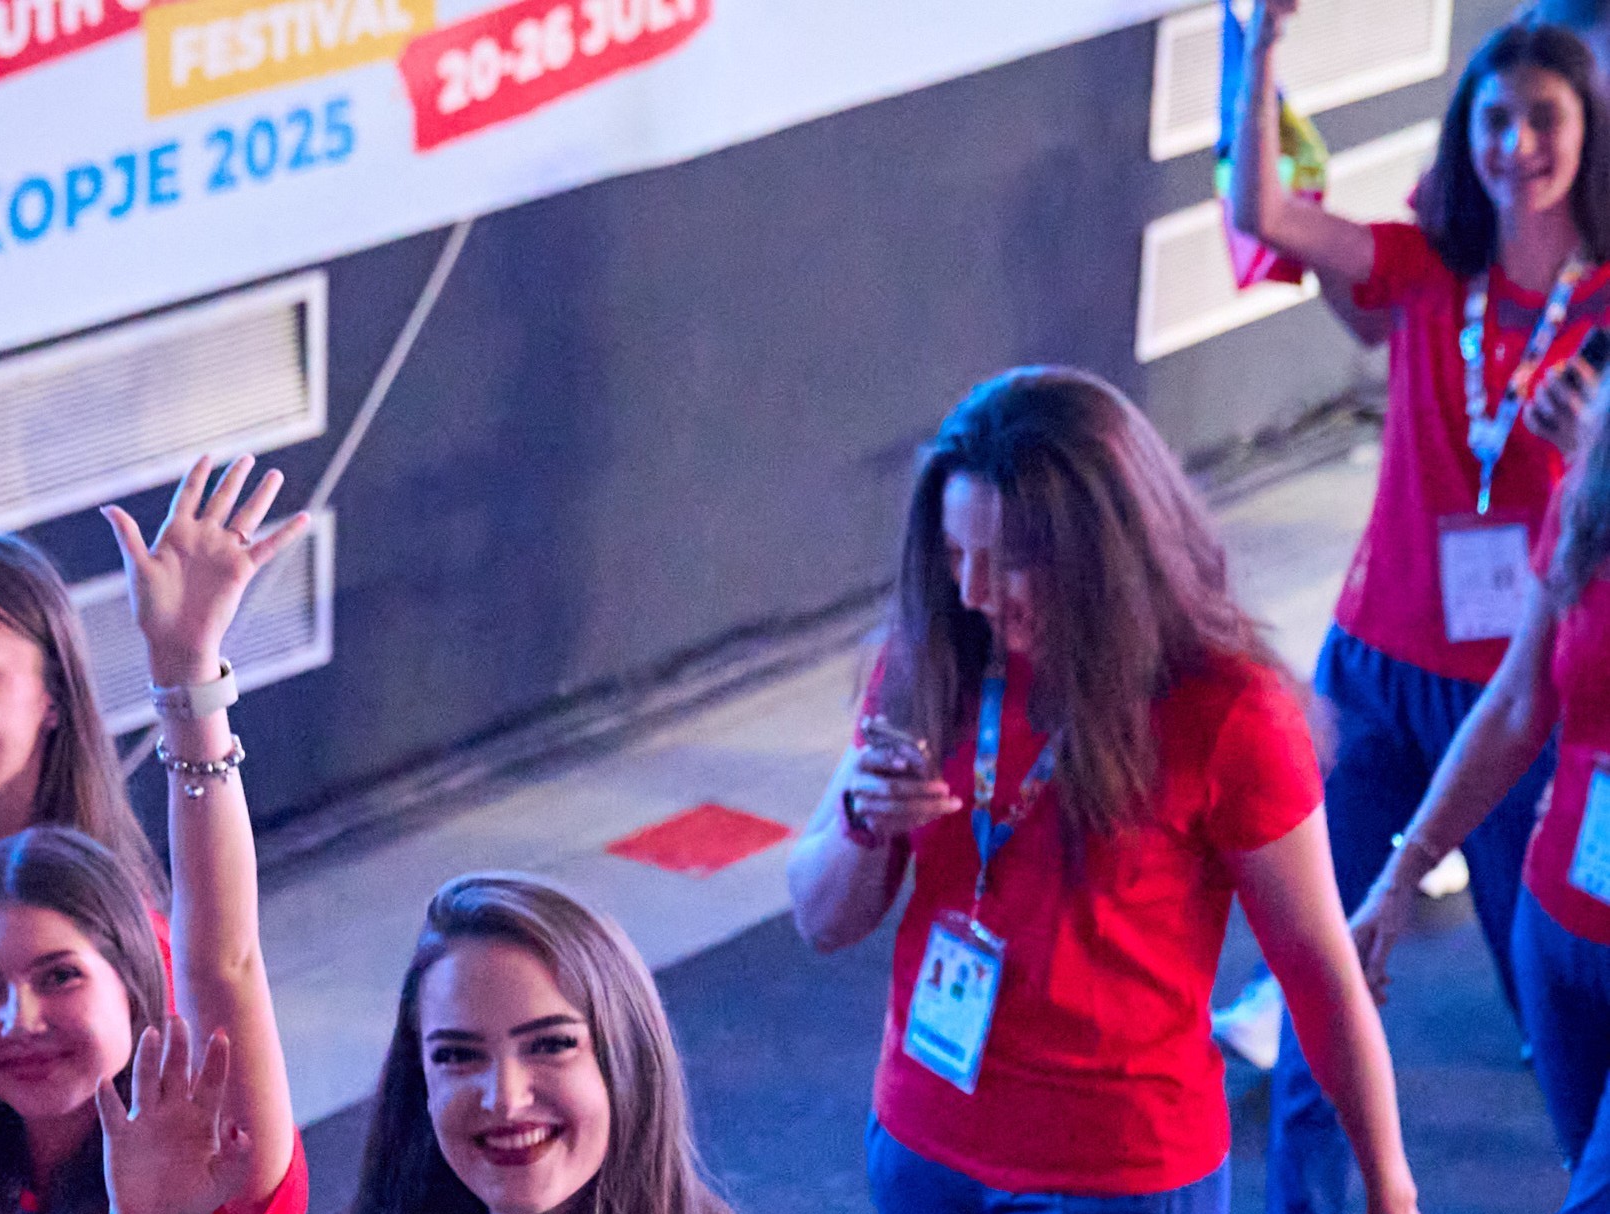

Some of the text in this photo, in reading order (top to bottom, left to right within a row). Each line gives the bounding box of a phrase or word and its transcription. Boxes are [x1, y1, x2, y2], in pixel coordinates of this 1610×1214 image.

[171, 0, 414, 86] FESTIVAL
[435, 3, 575, 115] 20-26
[205, 97, 357, 194] 2025
